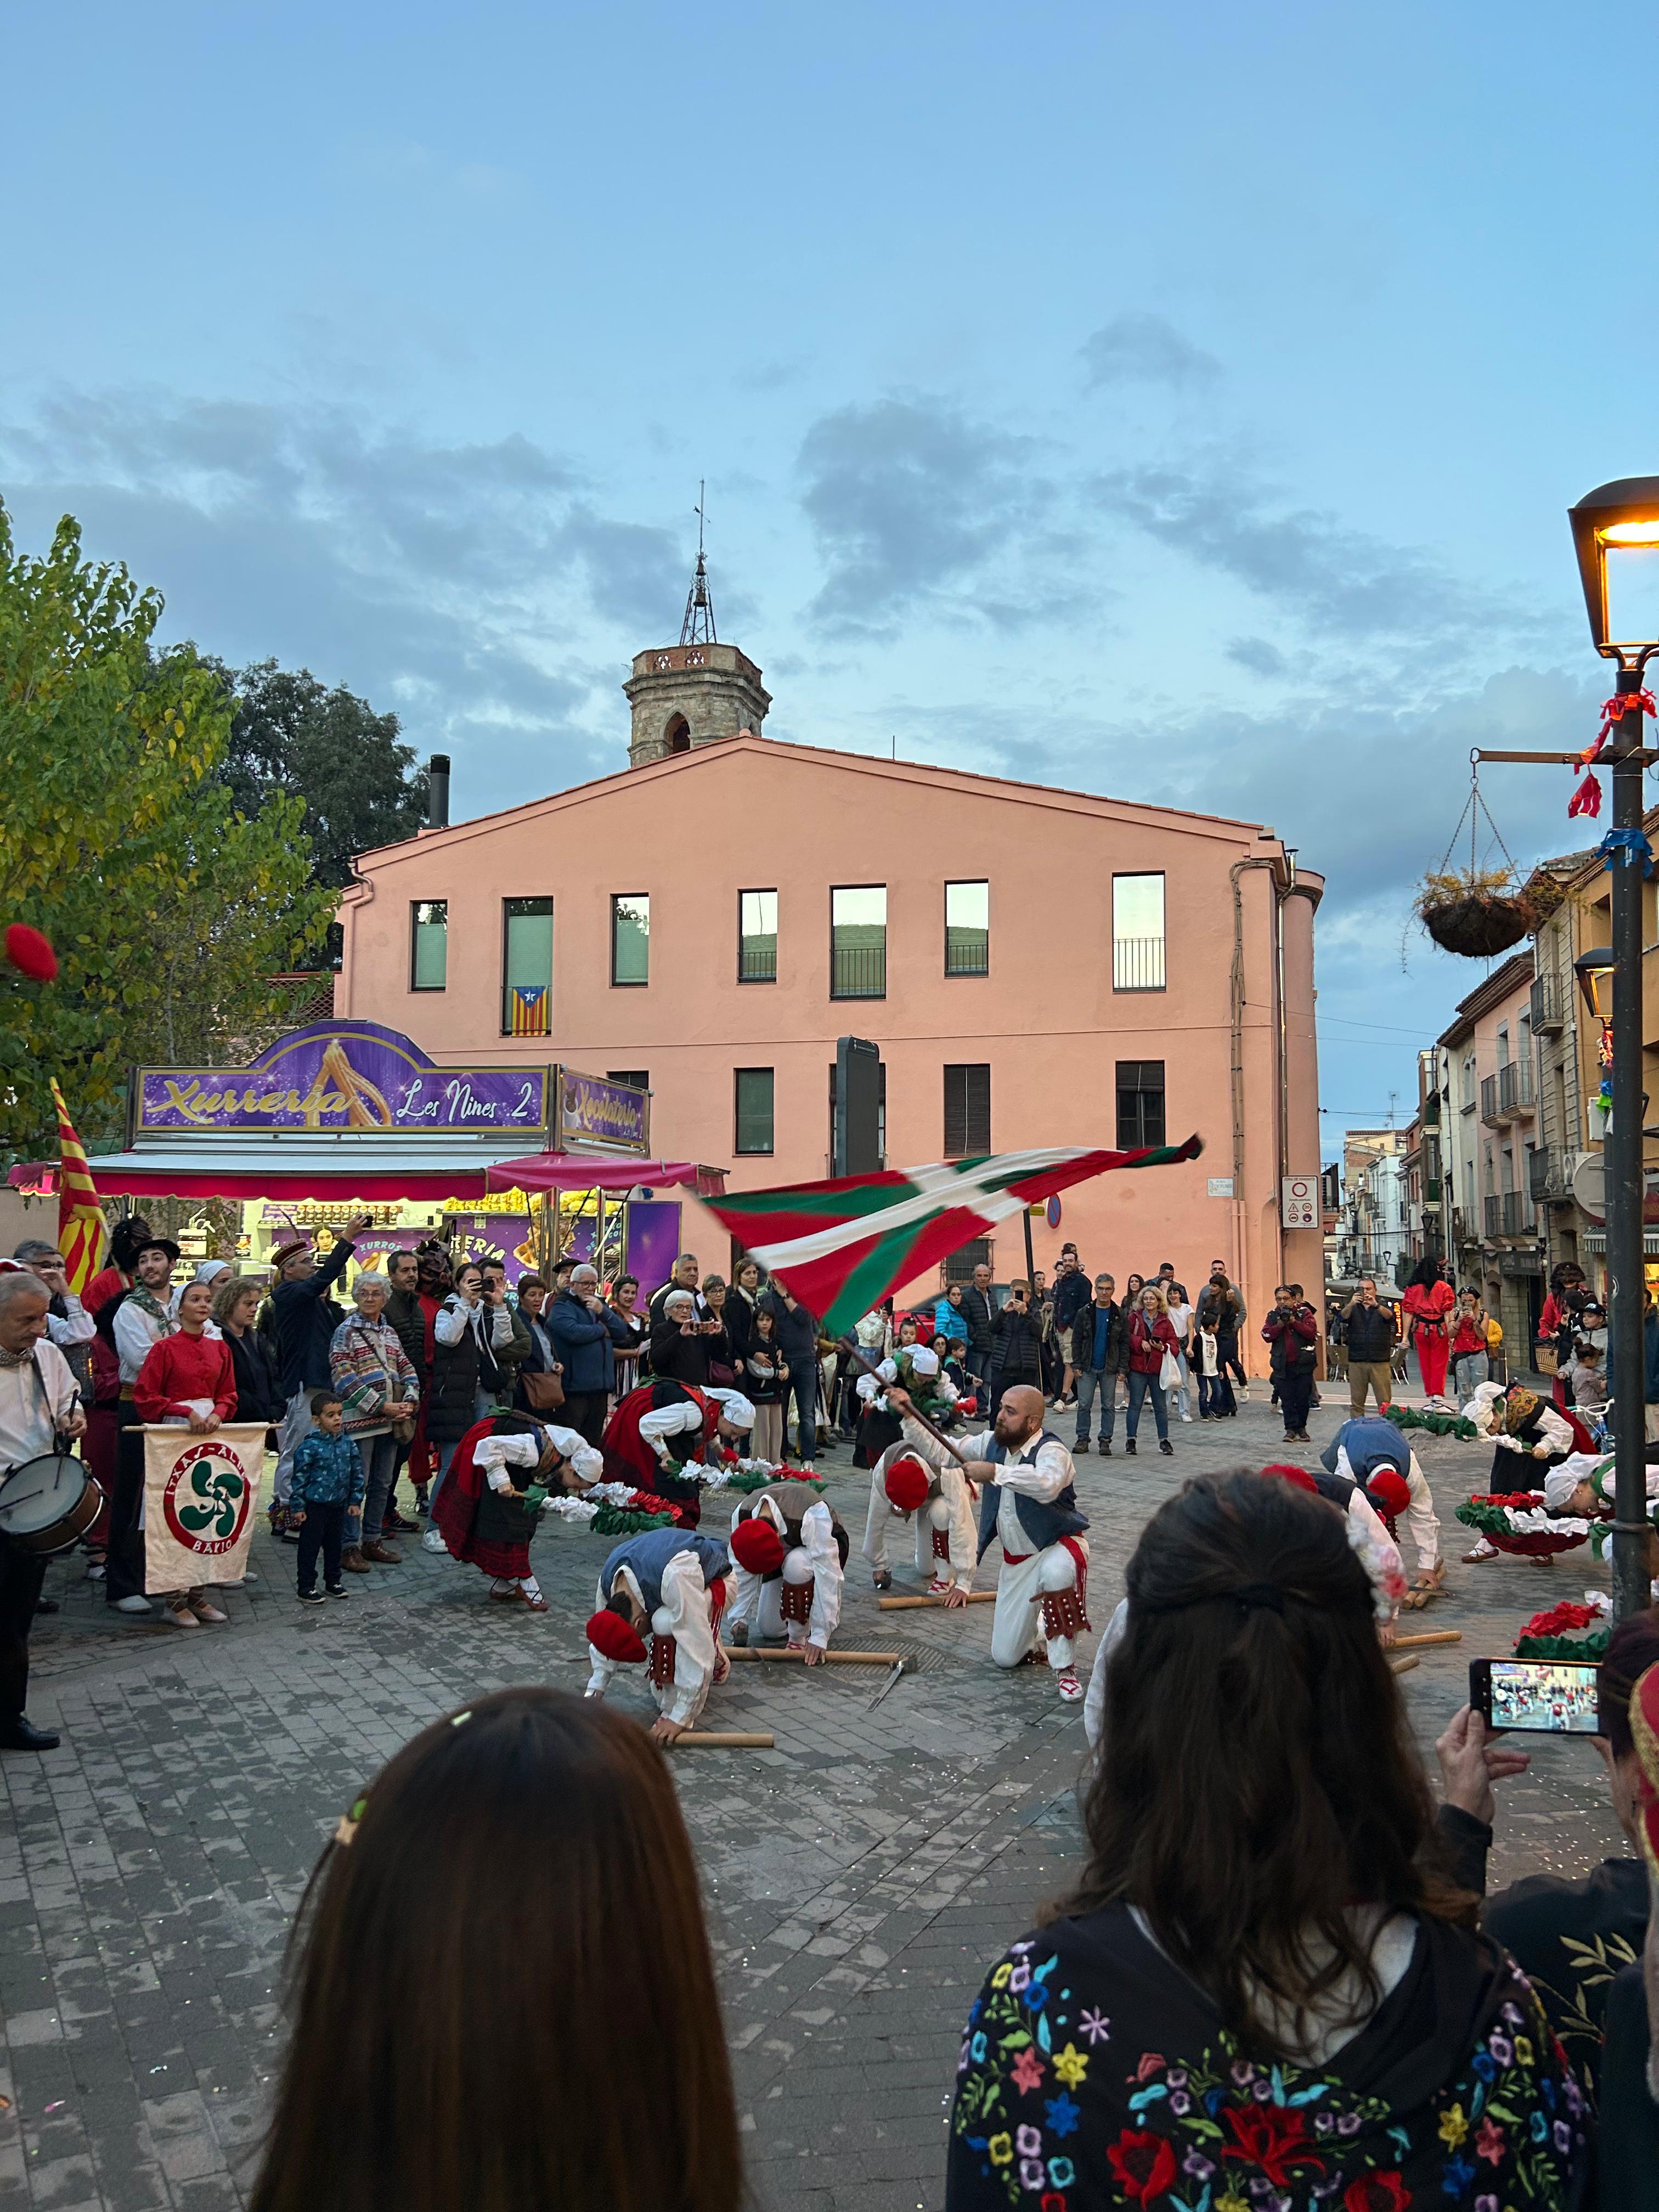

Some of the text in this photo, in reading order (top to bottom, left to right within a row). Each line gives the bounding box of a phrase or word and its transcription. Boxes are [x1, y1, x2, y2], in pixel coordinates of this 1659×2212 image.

[146, 1079, 356, 1124] Xurreria
[396, 1079, 532, 1123] Les Nines 2
[359, 1241, 403, 1252] XURROS
[193, 1539, 232, 1554] BAKIO
